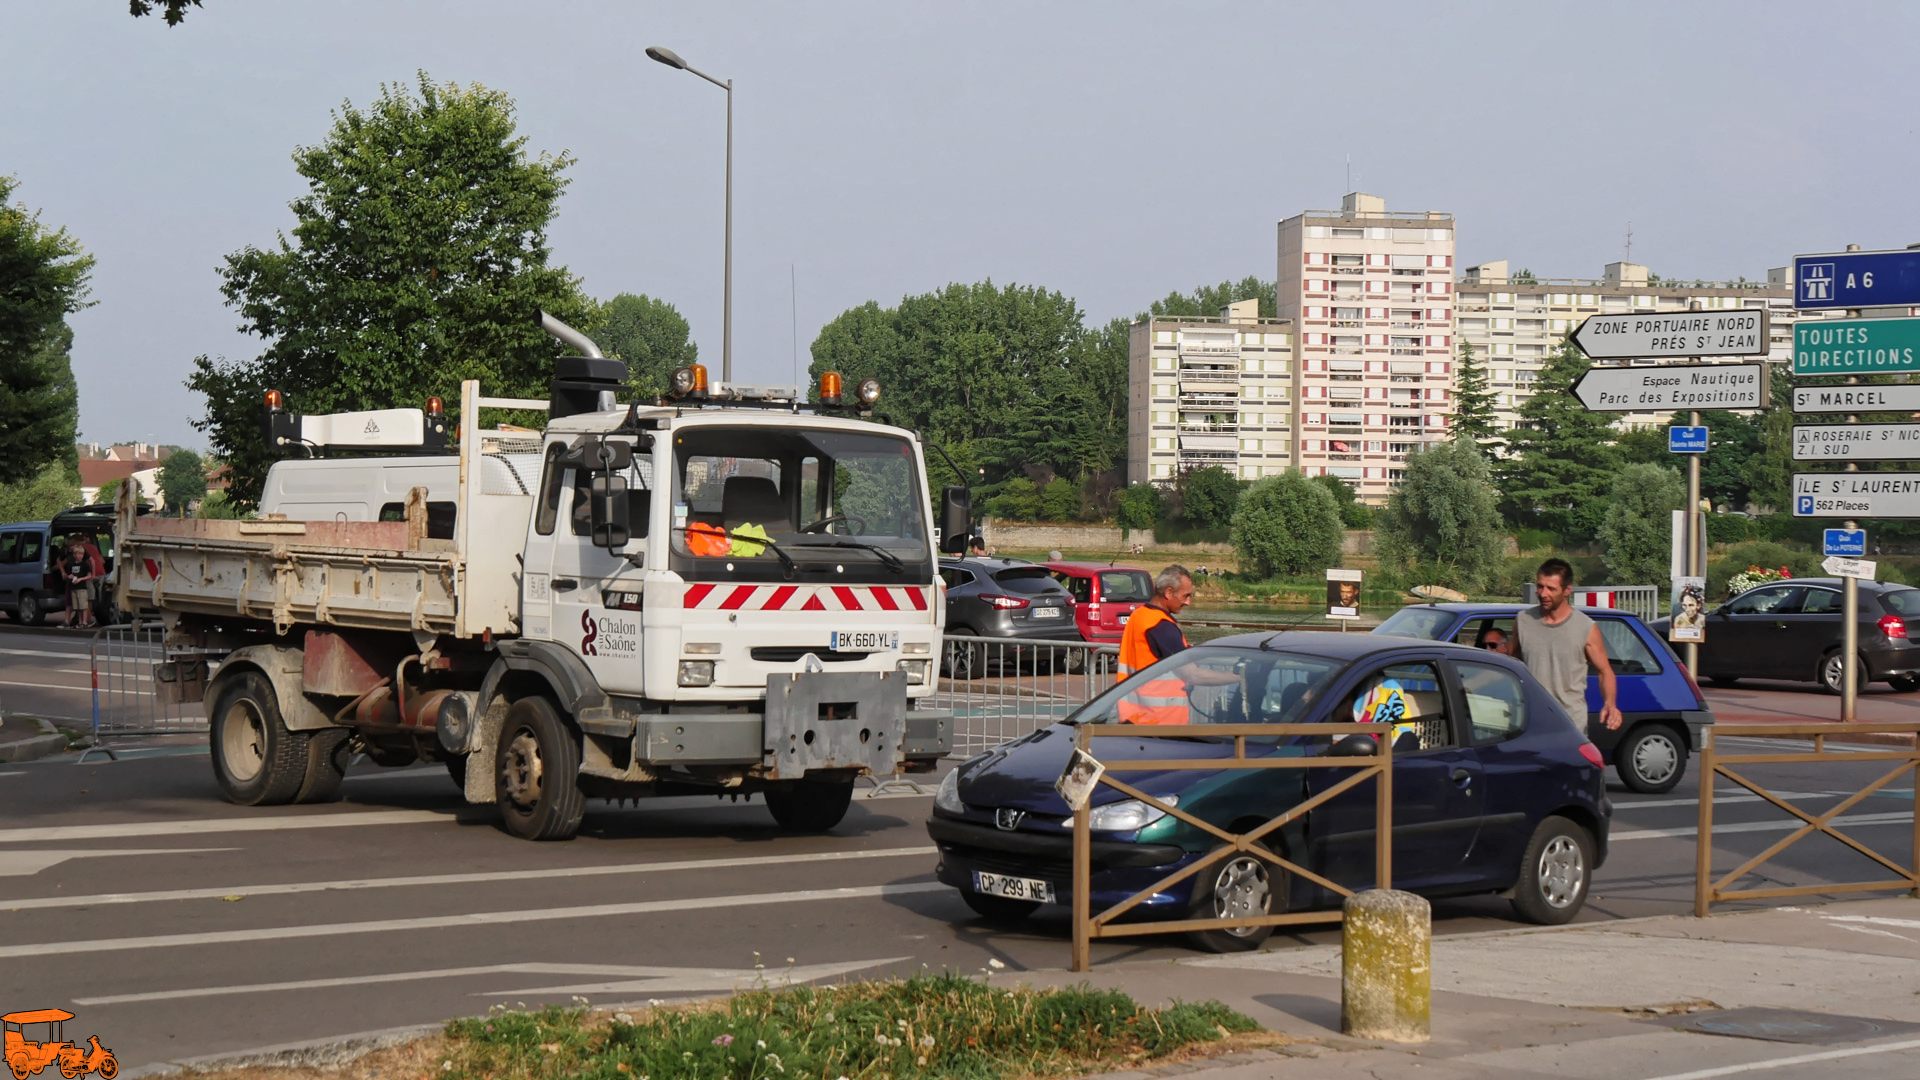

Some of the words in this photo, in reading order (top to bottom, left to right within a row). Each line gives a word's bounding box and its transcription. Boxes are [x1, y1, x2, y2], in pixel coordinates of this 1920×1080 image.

[1593, 321, 1629, 335] ZONE
[1635, 318, 1710, 333] PORTUAIRE
[1716, 317, 1755, 331] NORD
[1650, 334, 1686, 350] PRÉS
[1718, 335, 1756, 348] JEAN
[1799, 327, 1868, 345] TOUTES
[1799, 347, 1914, 367] DIRECTIONS
[1642, 376, 1681, 388] Espace
[1690, 372, 1755, 387] Nautique
[1599, 392, 1629, 405] Parc
[1639, 391, 1663, 403] des
[1671, 389, 1755, 406] Expositions
[1820, 392, 1886, 405] MARCEL
[1687, 440, 1706, 448] MARIE
[1812, 430, 1873, 442] ROSERAIE
[1823, 444, 1850, 455] SUD
[1797, 477, 1821, 494] ÎLE
[1851, 480, 1920, 494] LAURENT
[1815, 500, 1834, 511] 562
[1835, 500, 1870, 511] Places
[623, 592, 639, 604] 150
[598, 617, 636, 635] Chalon
[605, 633, 636, 651] Saône
